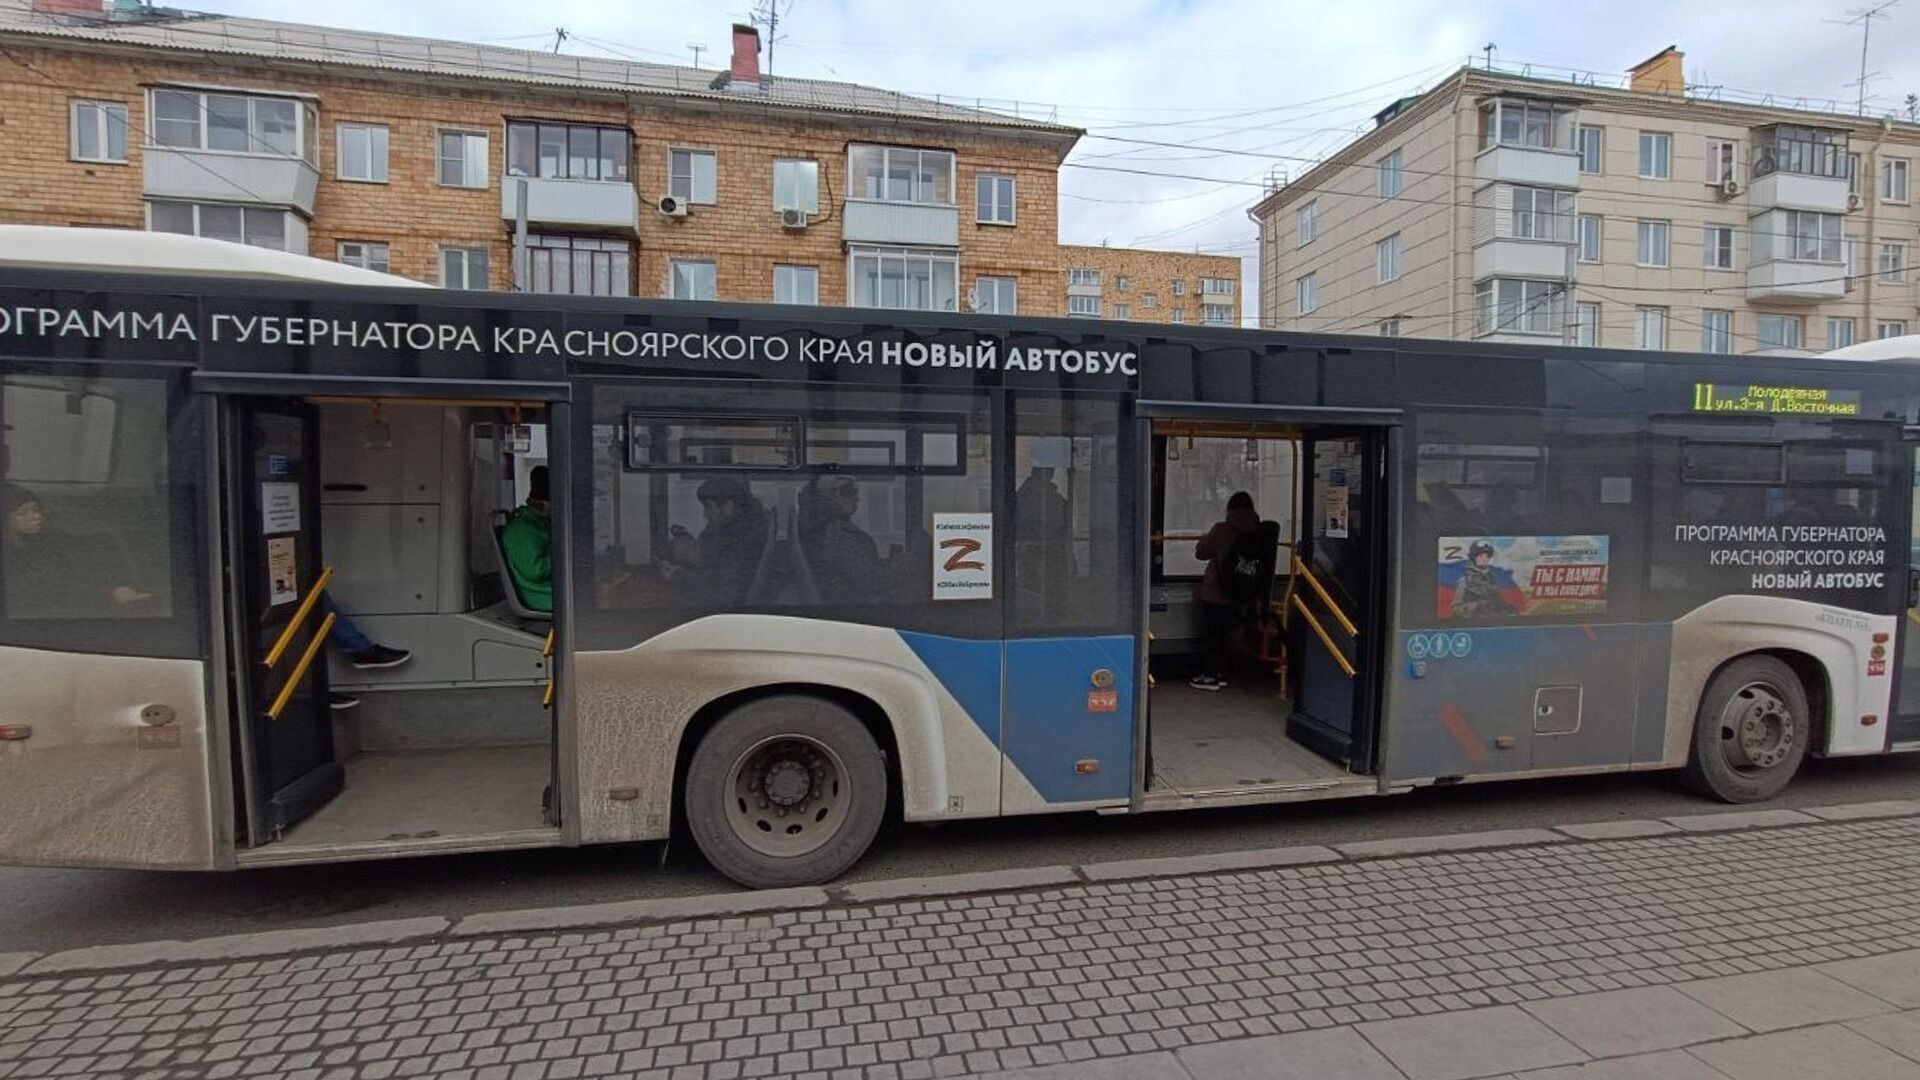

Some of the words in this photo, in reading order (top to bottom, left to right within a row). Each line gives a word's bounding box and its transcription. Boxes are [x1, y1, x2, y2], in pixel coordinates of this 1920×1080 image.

[211, 314, 481, 353] ГУБЕРНАТОРА
[493, 327, 790, 362] КРАСНОЯРСКОГО
[799, 336, 873, 365] КРАЯ
[881, 339, 997, 371] НОВЫЙ
[1004, 347, 1138, 376] АВТОБУС
[1694, 383, 1713, 410] 11
[1675, 525, 1778, 541] ПРОГРАММА
[1781, 526, 1886, 542] ГУБЕРНАТОРА
[1710, 549, 1845, 566] КРАСНОЯРСКОГО
[1847, 549, 1884, 565] КРАЯ
[1752, 570, 1812, 589] НОВЫЙ
[1813, 572, 1884, 588] АВТОБУС
